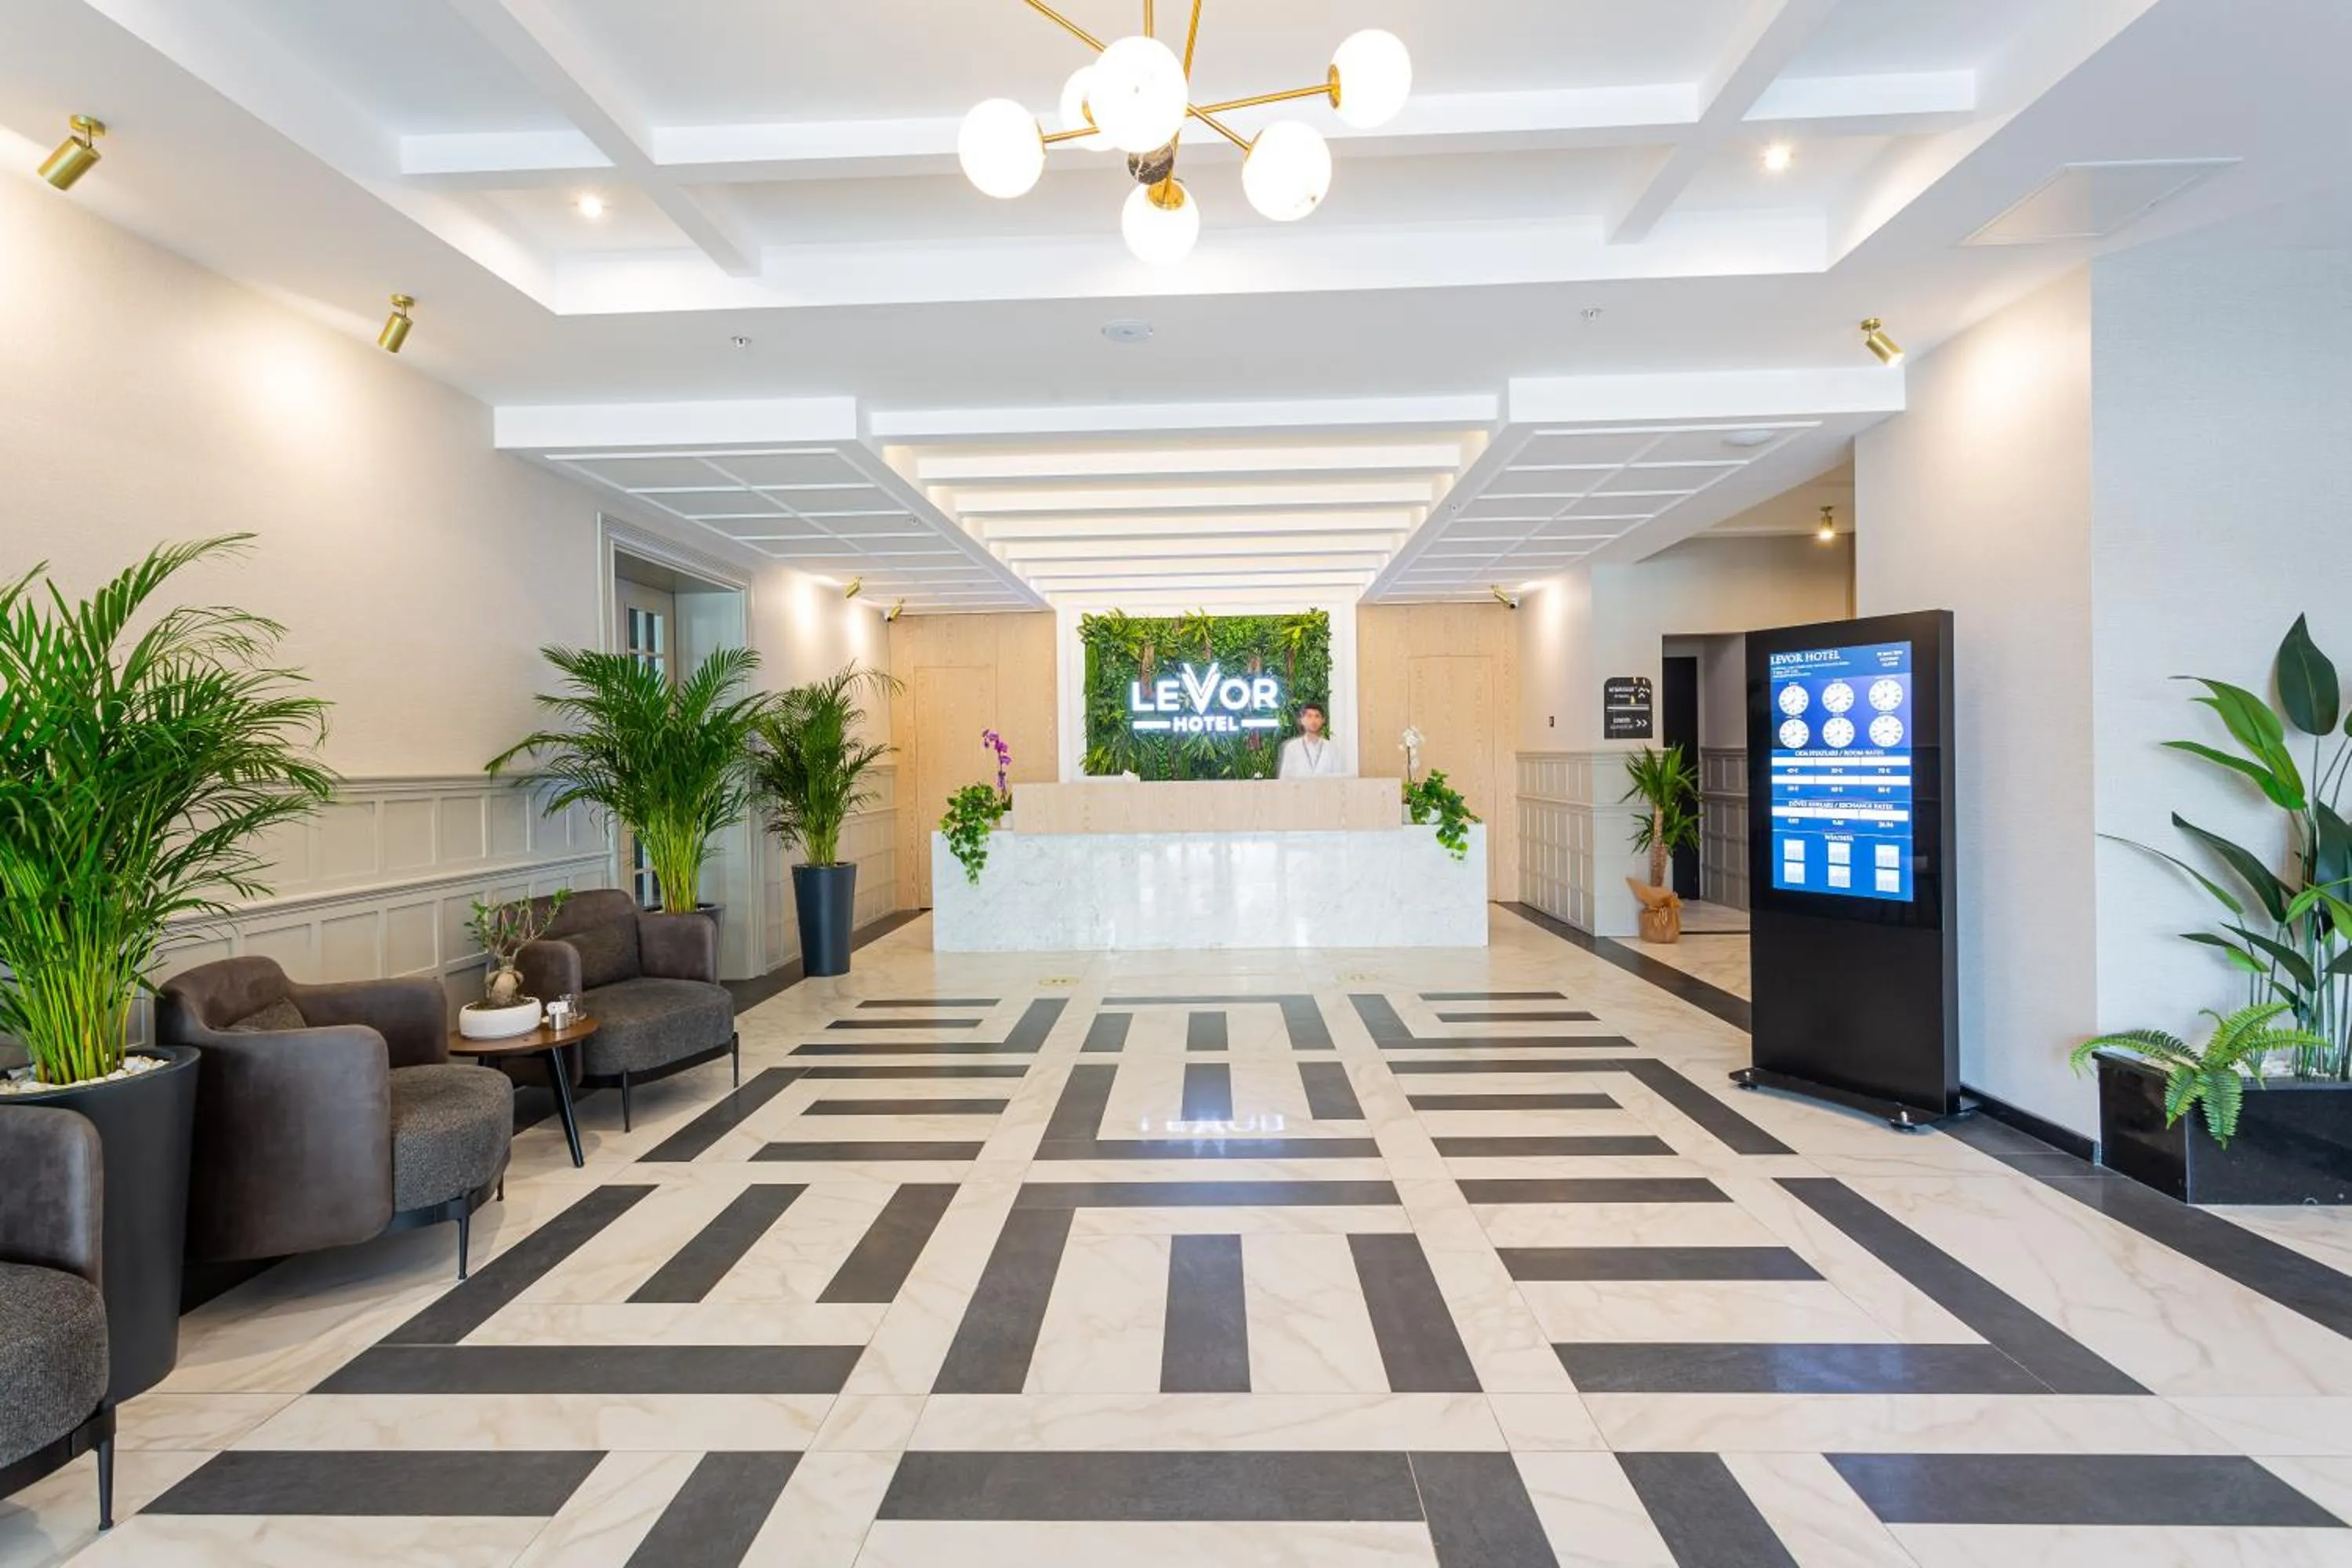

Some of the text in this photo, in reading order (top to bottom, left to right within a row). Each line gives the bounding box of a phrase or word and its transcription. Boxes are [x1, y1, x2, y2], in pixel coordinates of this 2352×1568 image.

[1770, 650, 1840, 665] LEVOR HOTEL
[1131, 662, 1279, 715] LEVOR
[1172, 715, 1240, 731] HOTEL
